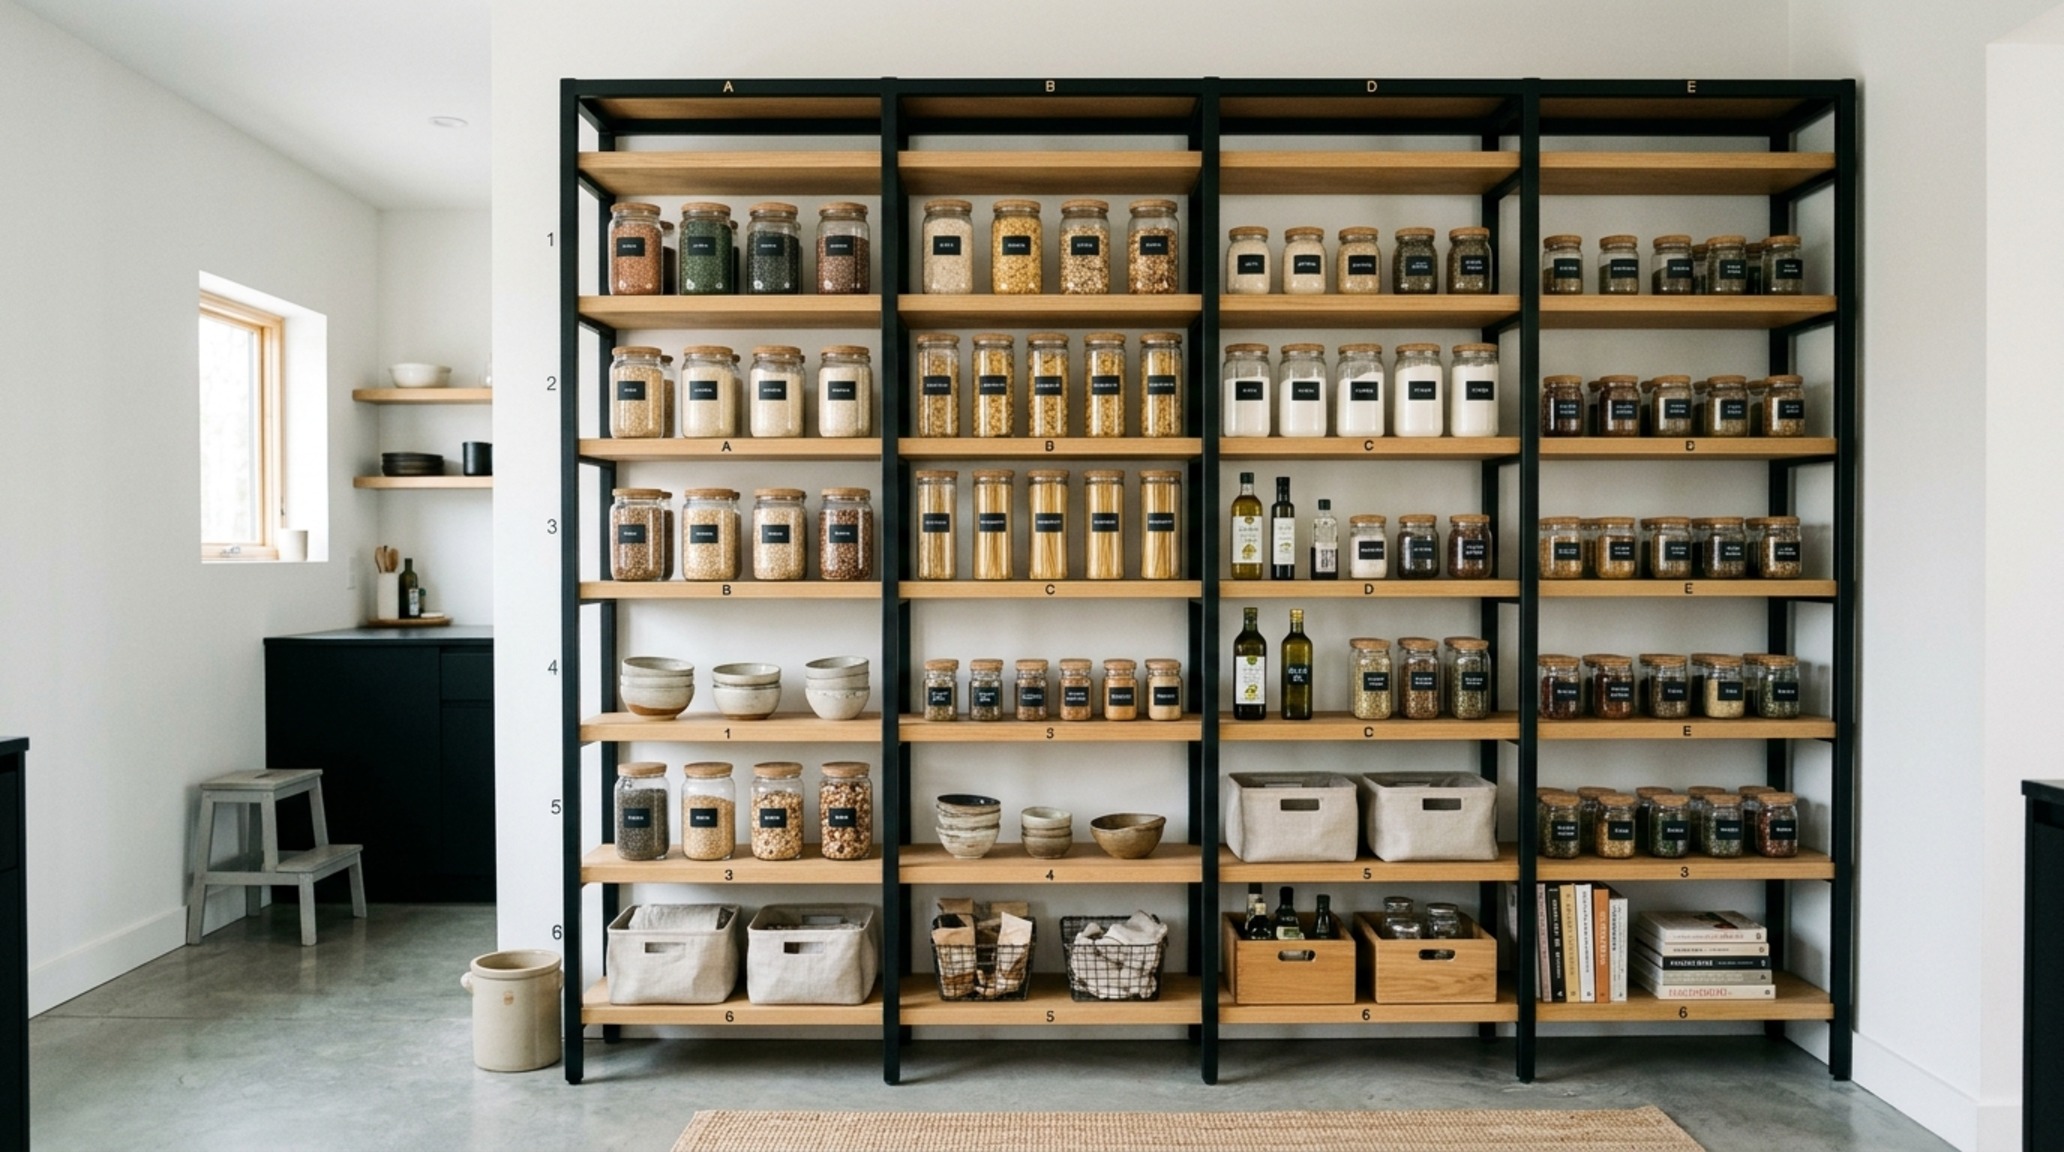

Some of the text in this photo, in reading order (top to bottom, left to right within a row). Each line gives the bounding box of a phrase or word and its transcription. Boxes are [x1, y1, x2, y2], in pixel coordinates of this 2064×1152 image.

[722, 80, 734, 92] A
[1046, 80, 1056, 92] B
[1368, 80, 1378, 92] D
[1688, 80, 1696, 92] E
[546, 232, 554, 246] 1
[546, 376, 556, 390] 2
[722, 442, 732, 452] A
[1046, 440, 1054, 452] B
[1364, 440, 1374, 452] C
[548, 518, 558, 534] 3
[722, 584, 732, 596] B
[1046, 584, 1056, 596] C
[1364, 584, 1374, 594] D
[1684, 582, 1692, 594] E
[548, 660, 558, 674] 4
[724, 728, 730, 738] 1
[1684, 726, 1692, 736] E
[552, 798, 562, 814] 5
[724, 870, 734, 880] 3
[1046, 870, 1054, 880] 4
[1364, 868, 1372, 880] 5
[1680, 866, 1688, 878] 3
[552, 924, 562, 940] 6
[726, 1010, 734, 1022] 6
[1362, 1008, 1370, 1020] 6
[1678, 1006, 1688, 1018] 6
